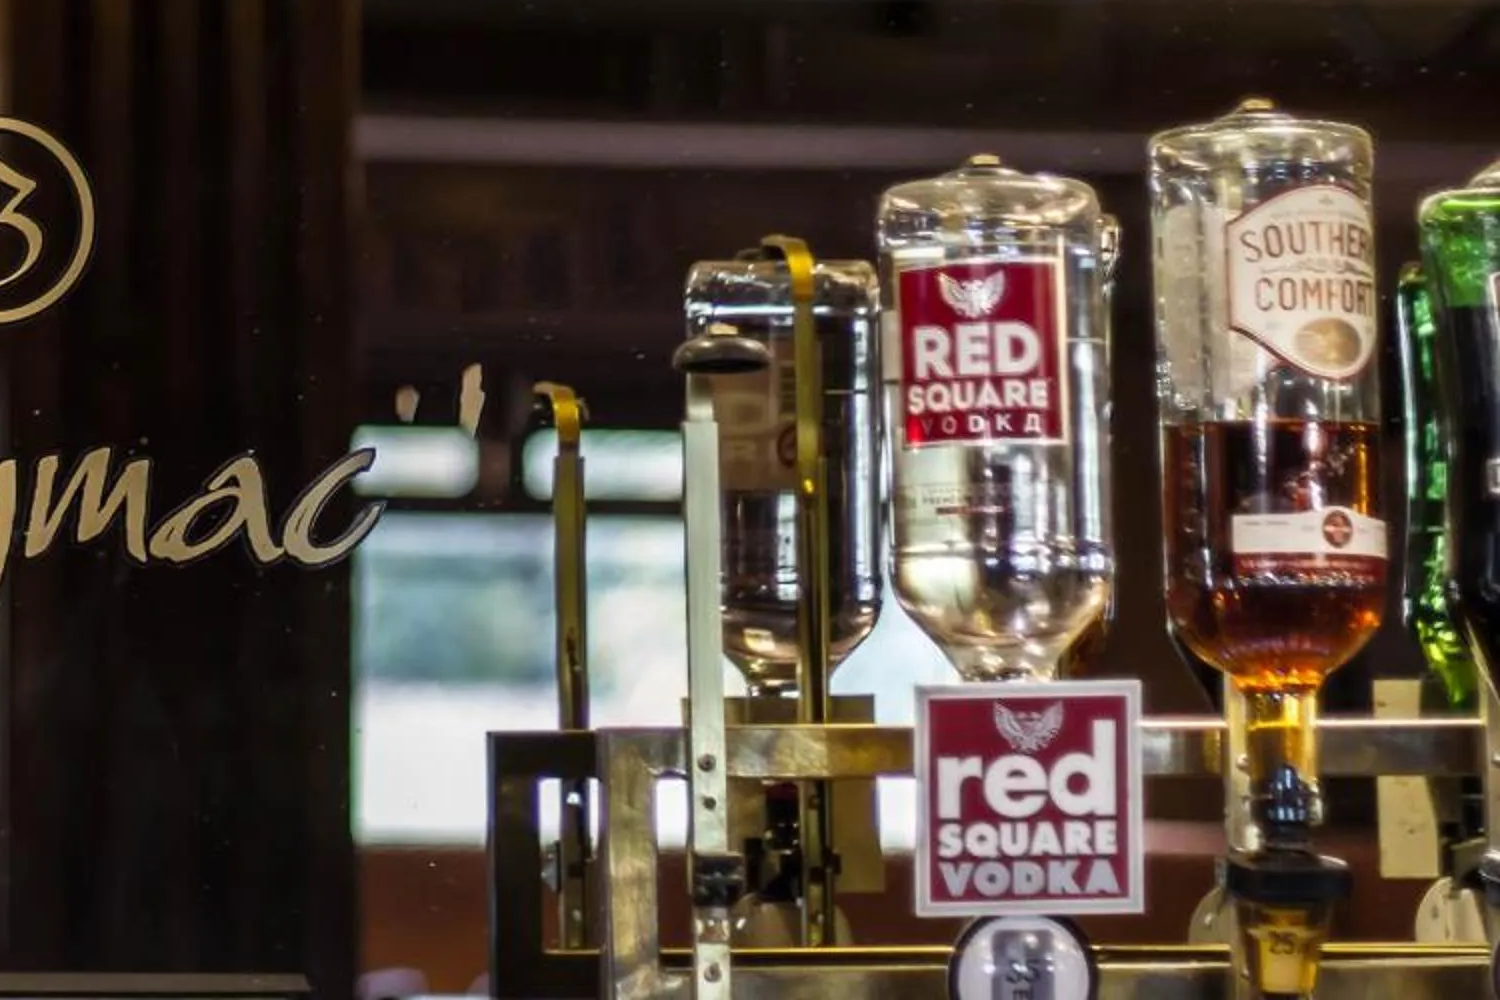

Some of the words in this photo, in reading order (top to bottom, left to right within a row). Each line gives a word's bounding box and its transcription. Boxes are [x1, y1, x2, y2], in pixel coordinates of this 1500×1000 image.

[1239, 221, 1368, 263] SOUTHER
[1255, 277, 1372, 317] COMFORT
[913, 321, 1040, 380] RED
[908, 379, 1048, 415] SQUARE
[937, 719, 1116, 820] red
[938, 820, 1117, 859] SQUARE
[938, 859, 1121, 896] VODKA
